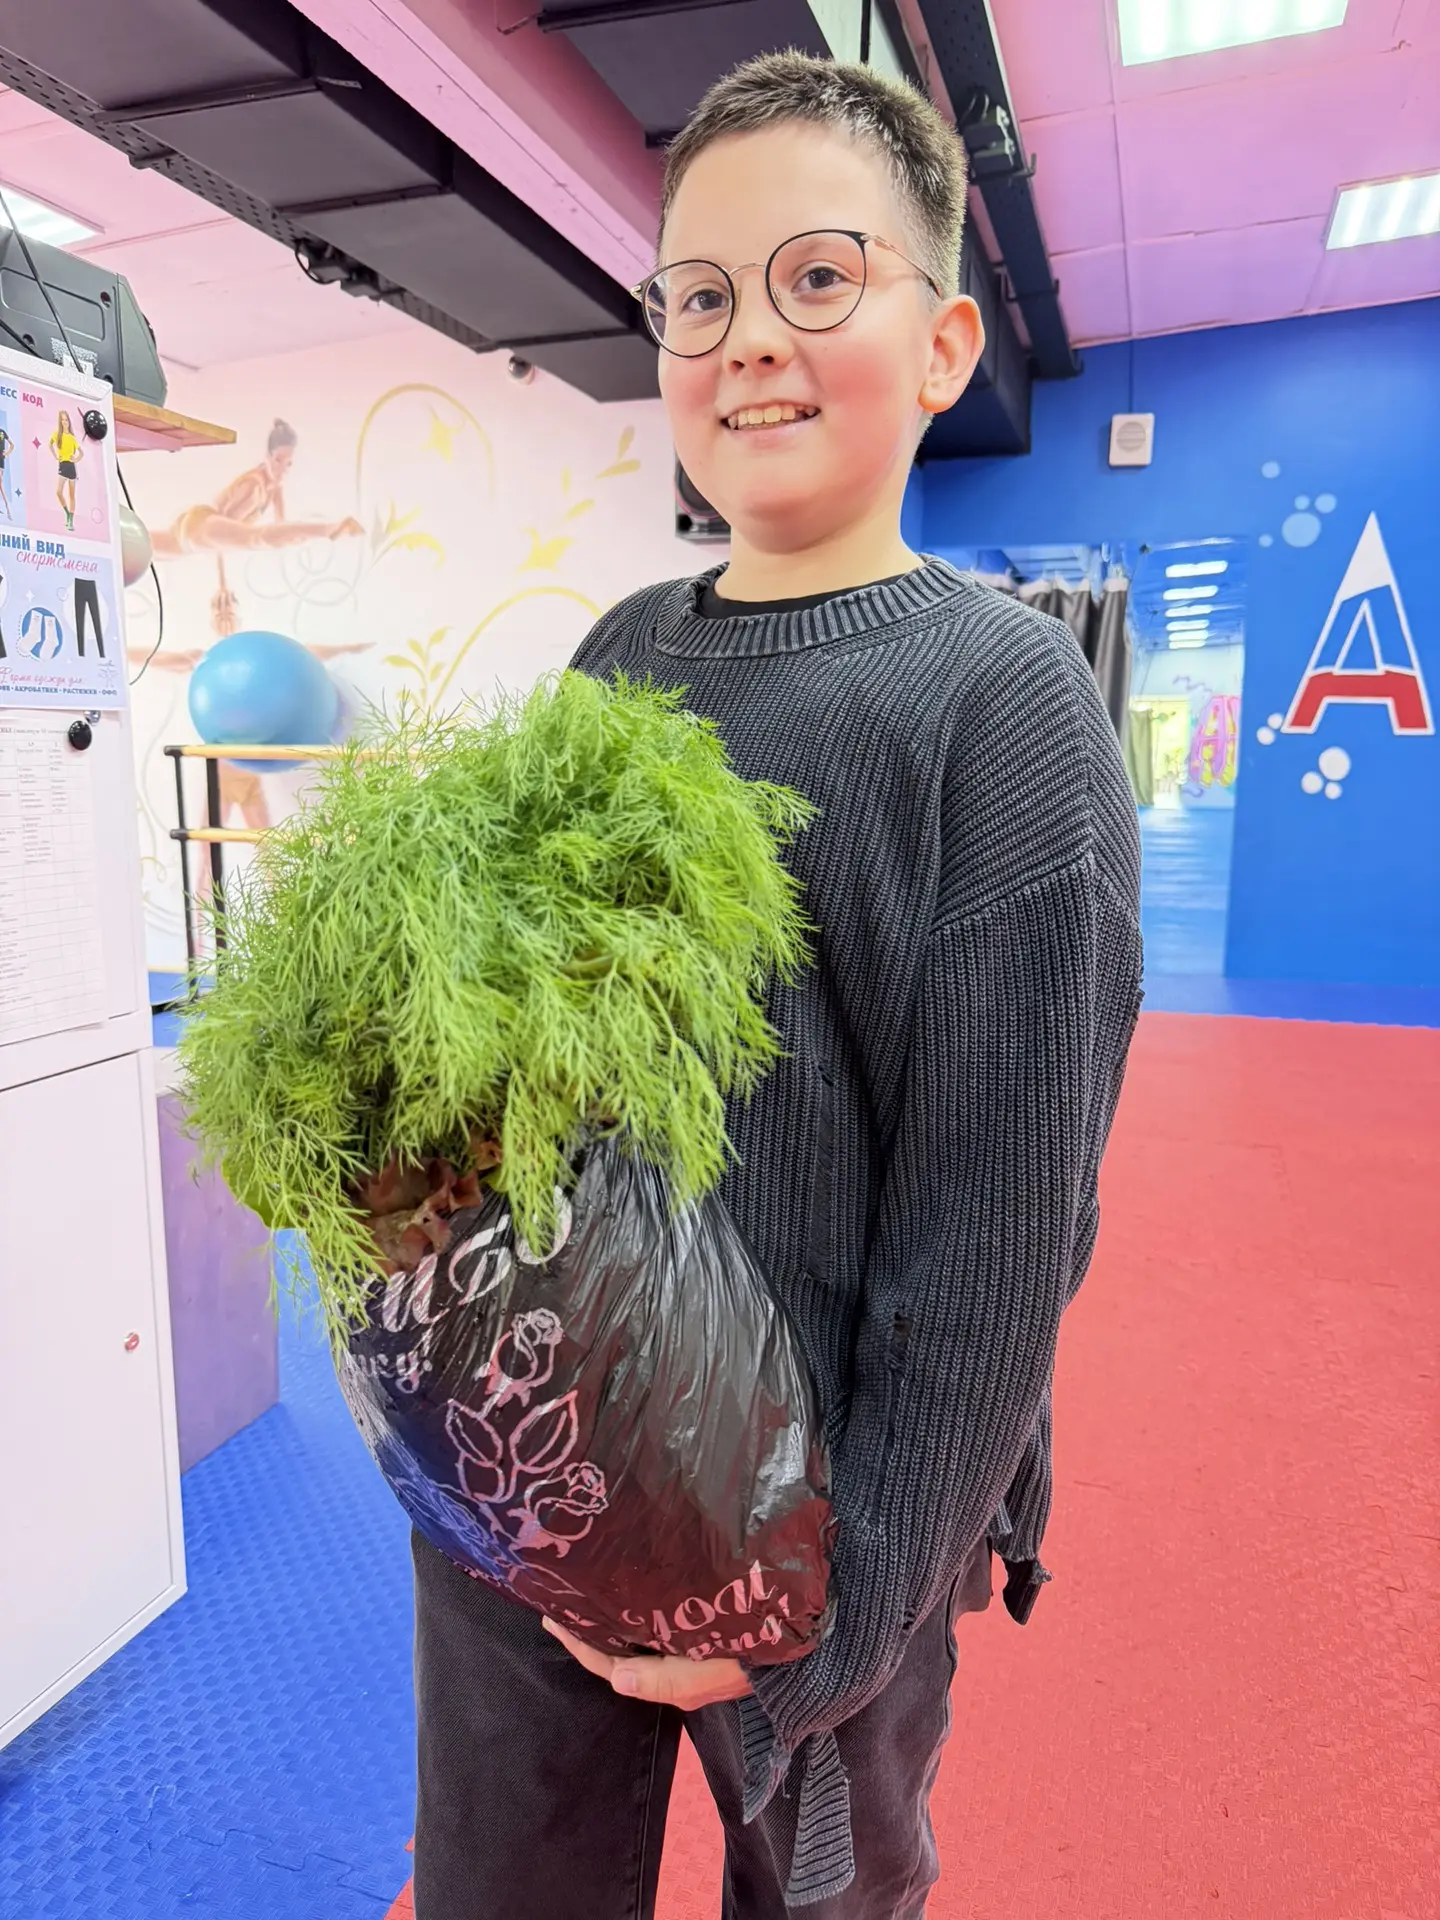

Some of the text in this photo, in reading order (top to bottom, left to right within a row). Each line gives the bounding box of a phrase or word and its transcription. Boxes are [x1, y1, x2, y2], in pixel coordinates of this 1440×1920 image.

[22, 392, 44, 408] КОД
[0, 533, 65, 560] НИЙ ВИД
